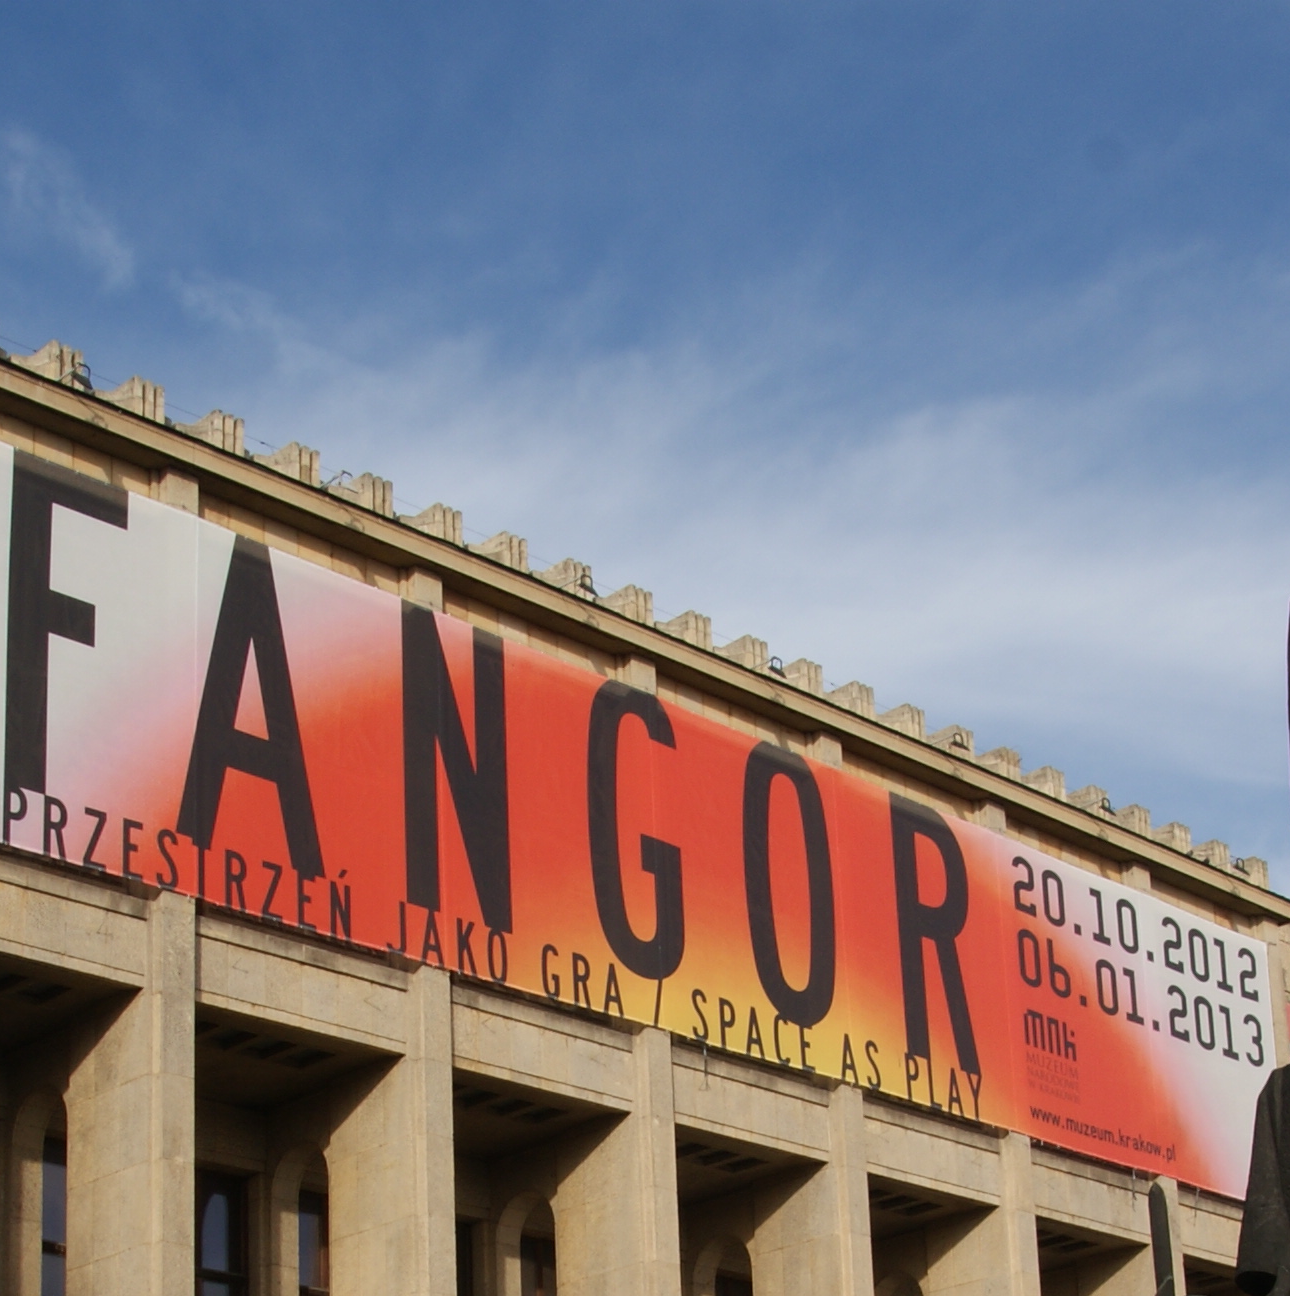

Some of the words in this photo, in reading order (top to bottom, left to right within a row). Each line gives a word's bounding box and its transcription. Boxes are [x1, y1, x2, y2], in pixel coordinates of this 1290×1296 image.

[4, 446, 982, 1076] FANGOR
[3, 785, 352, 943] PRZESTRZEŃ
[387, 901, 508, 985] JAKO
[541, 944, 625, 1019] GRA
[691, 988, 816, 1073] SPACE
[841, 1033, 882, 1090] AS
[905, 1052, 983, 1122] PLAY
[1012, 856, 1260, 1003] 20.10.2012
[1017, 928, 1265, 1068] 06.01.2013
[1026, 1052, 1079, 1080] MUZEUM
[1030, 1106, 1177, 1163] www.muzeum.krakow.pl
